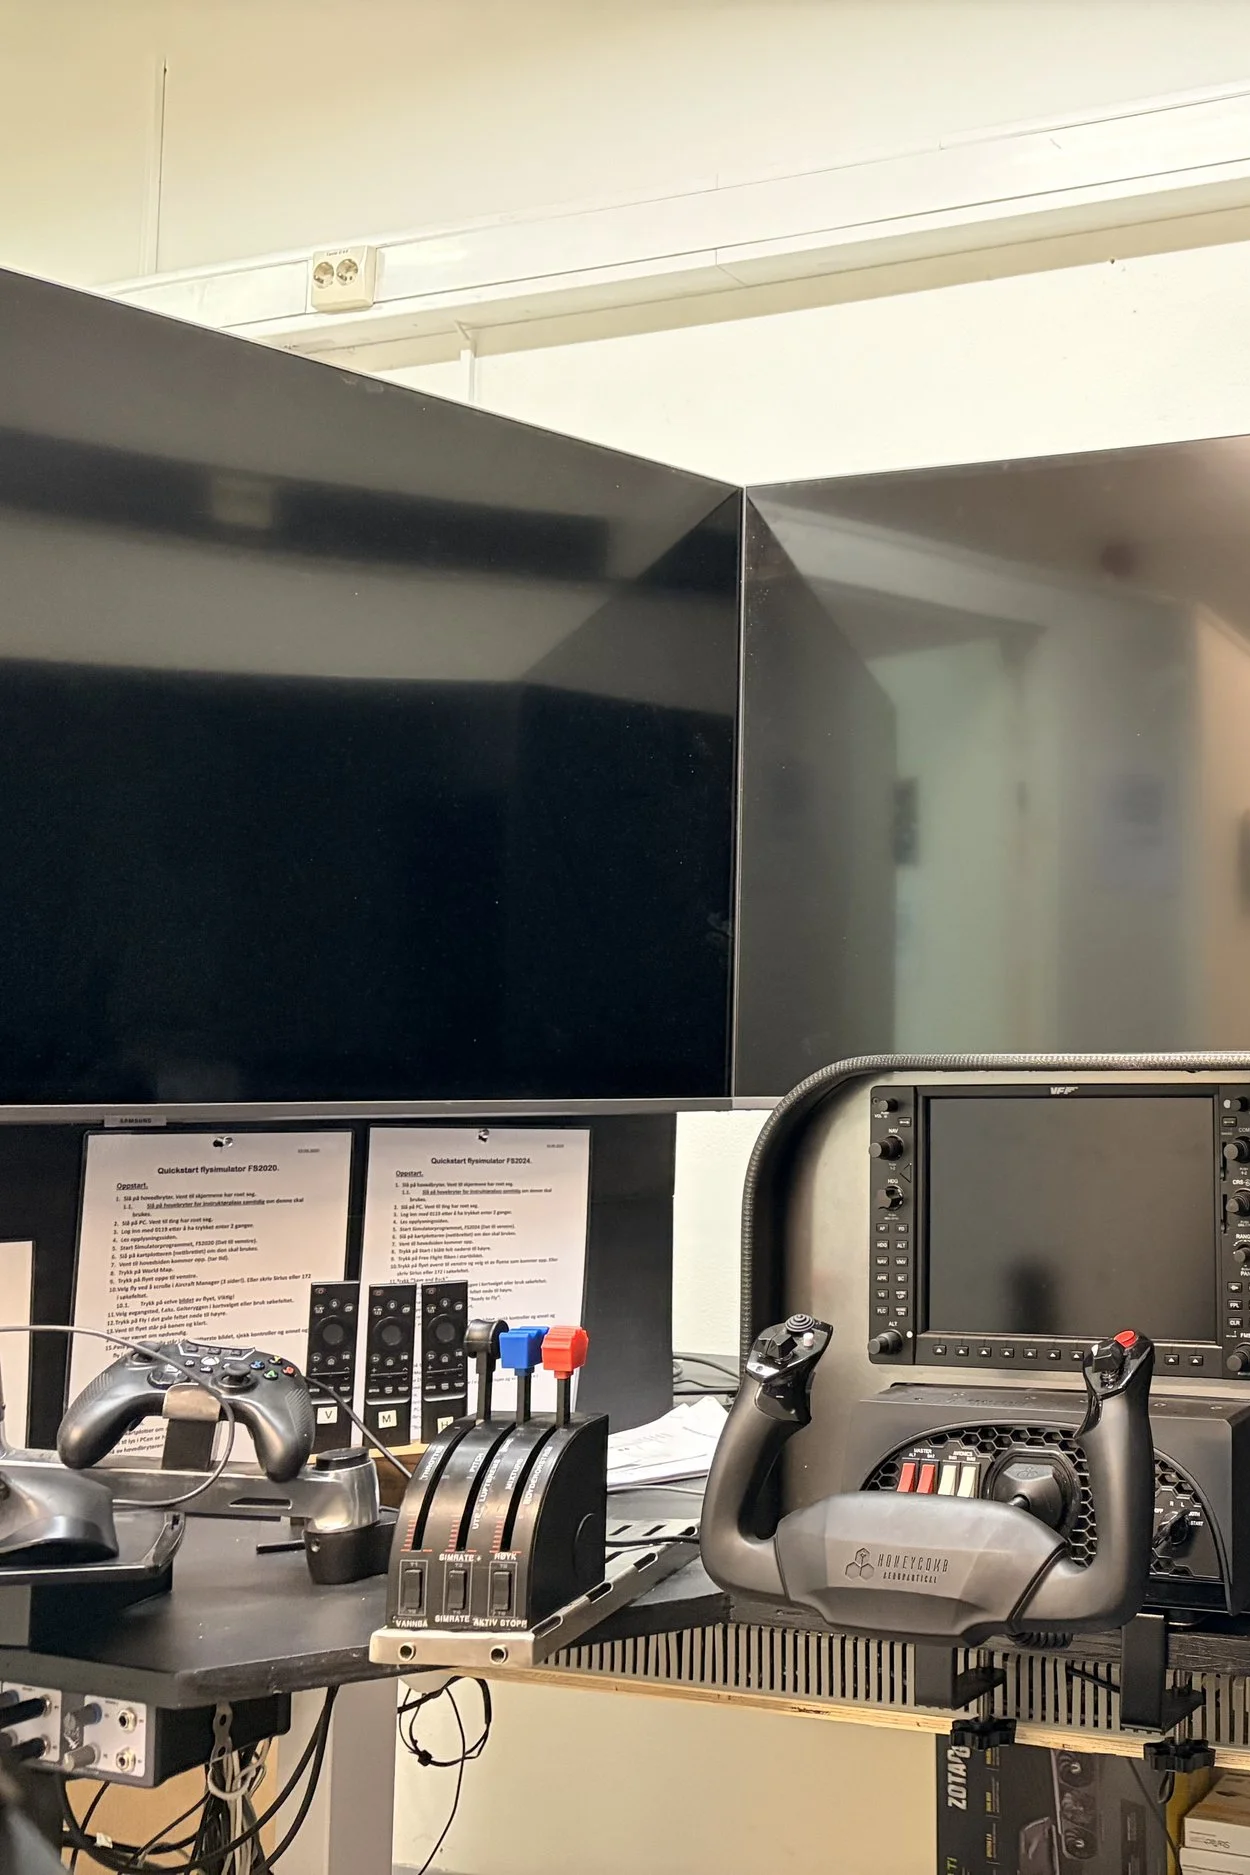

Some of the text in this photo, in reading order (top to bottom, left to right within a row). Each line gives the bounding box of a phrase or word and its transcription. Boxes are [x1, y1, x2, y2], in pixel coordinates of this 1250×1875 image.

[431, 1156, 532, 1165] Quickstart flysimulator FS2024.
[382, 1415, 391, 1423] M
[469, 1453, 485, 1472] PITCH
[878, 1553, 949, 1572] HONEYCOMB
[883, 1572, 937, 1583] AERONAUTICAL
